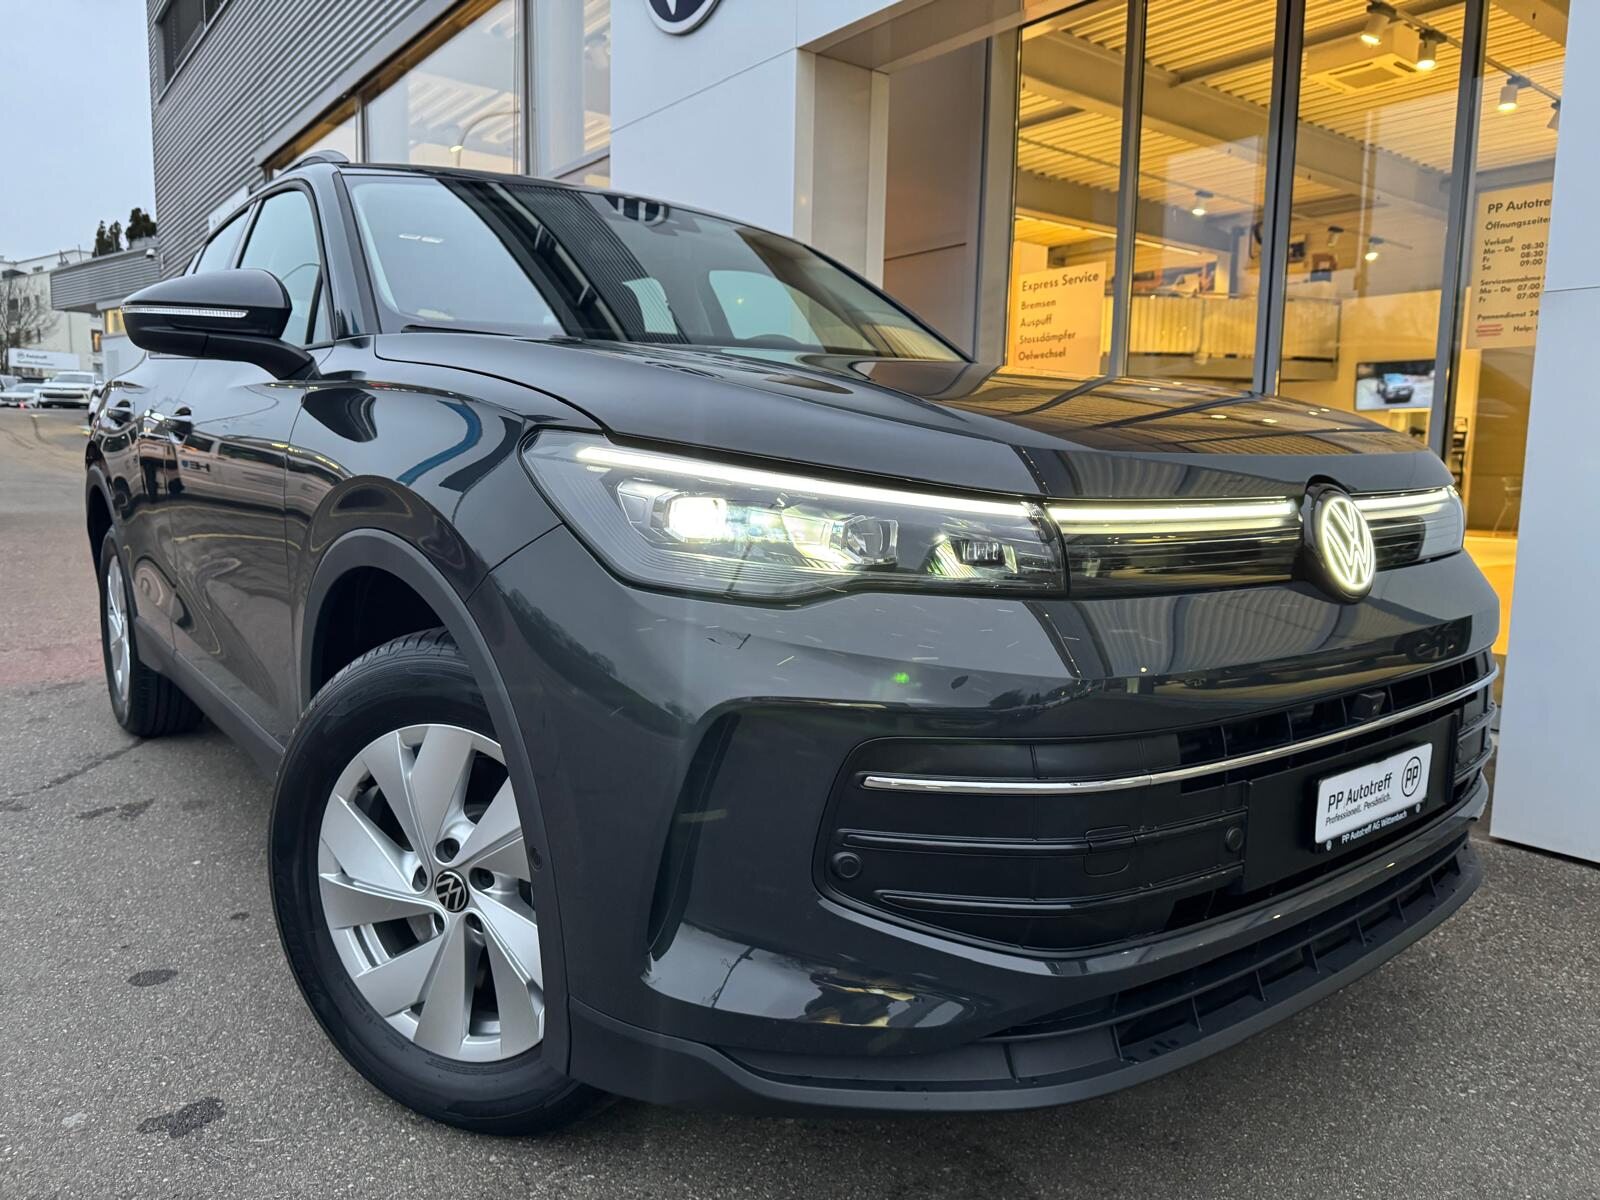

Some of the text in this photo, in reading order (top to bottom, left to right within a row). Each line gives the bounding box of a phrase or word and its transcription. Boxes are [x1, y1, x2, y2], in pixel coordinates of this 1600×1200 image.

[1488, 202, 1503, 214] PP
[1484, 236, 1513, 246] Verkauf
[1022, 272, 1100, 293] Express Service
[1021, 299, 1057, 310] Bremsen
[1020, 313, 1052, 328] Auspuff
[1019, 330, 1076, 345] Stossdämpfer
[1018, 347, 1067, 361] Oelwechsel
[1404, 765, 1419, 789] PP
[1328, 772, 1393, 813] PP Autotreff
[1341, 834, 1351, 845] PP
[1350, 824, 1372, 841] Autotreff
[1372, 820, 1381, 831] AG
